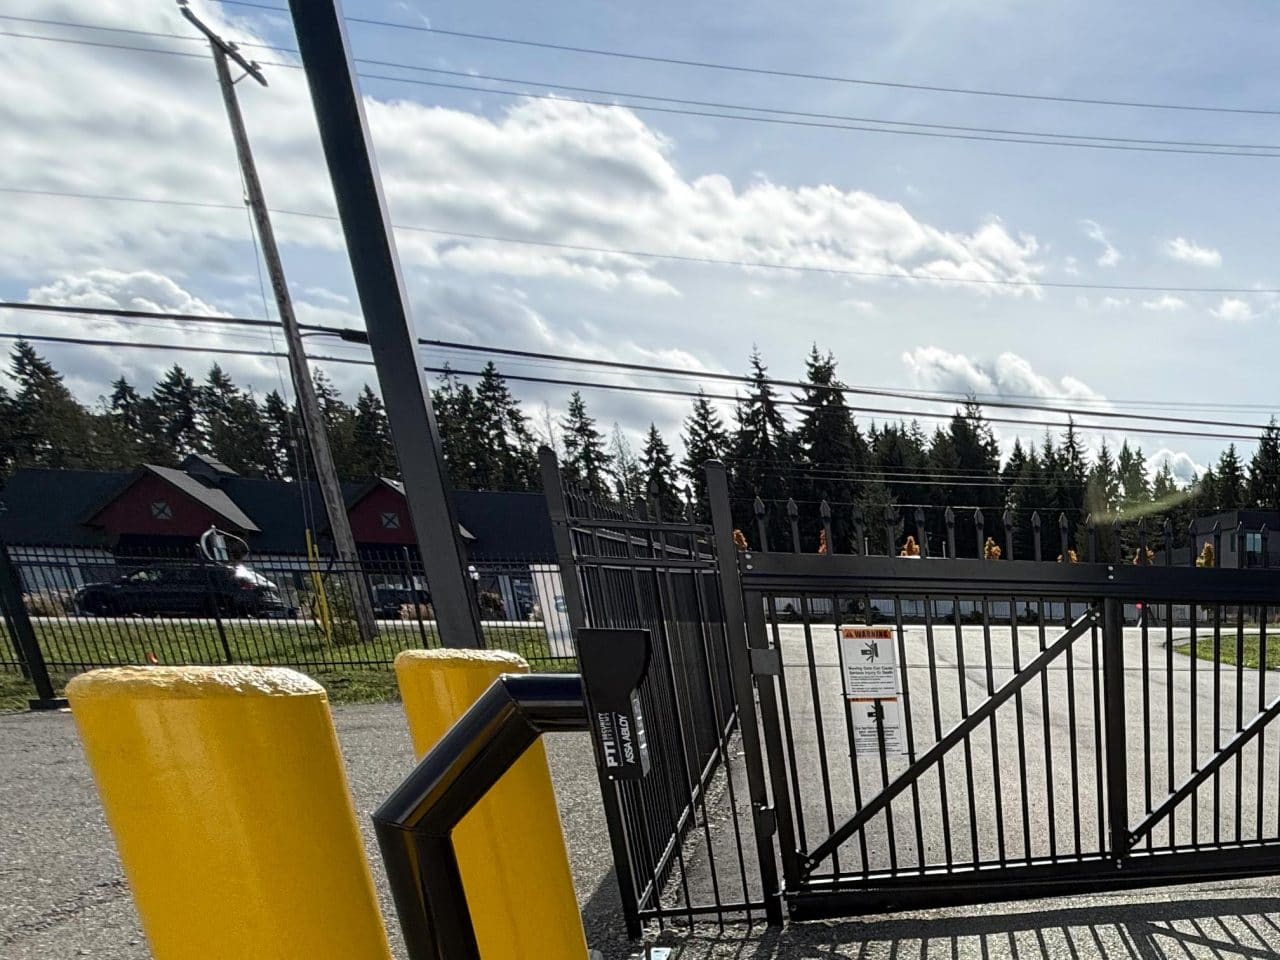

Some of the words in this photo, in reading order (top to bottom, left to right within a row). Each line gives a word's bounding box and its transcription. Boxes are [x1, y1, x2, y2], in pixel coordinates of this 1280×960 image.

[854, 629, 889, 638] WARNING
[618, 714, 631, 742] ABLOY
[603, 741, 618, 767] PTI
[623, 742, 635, 764] ASSA
